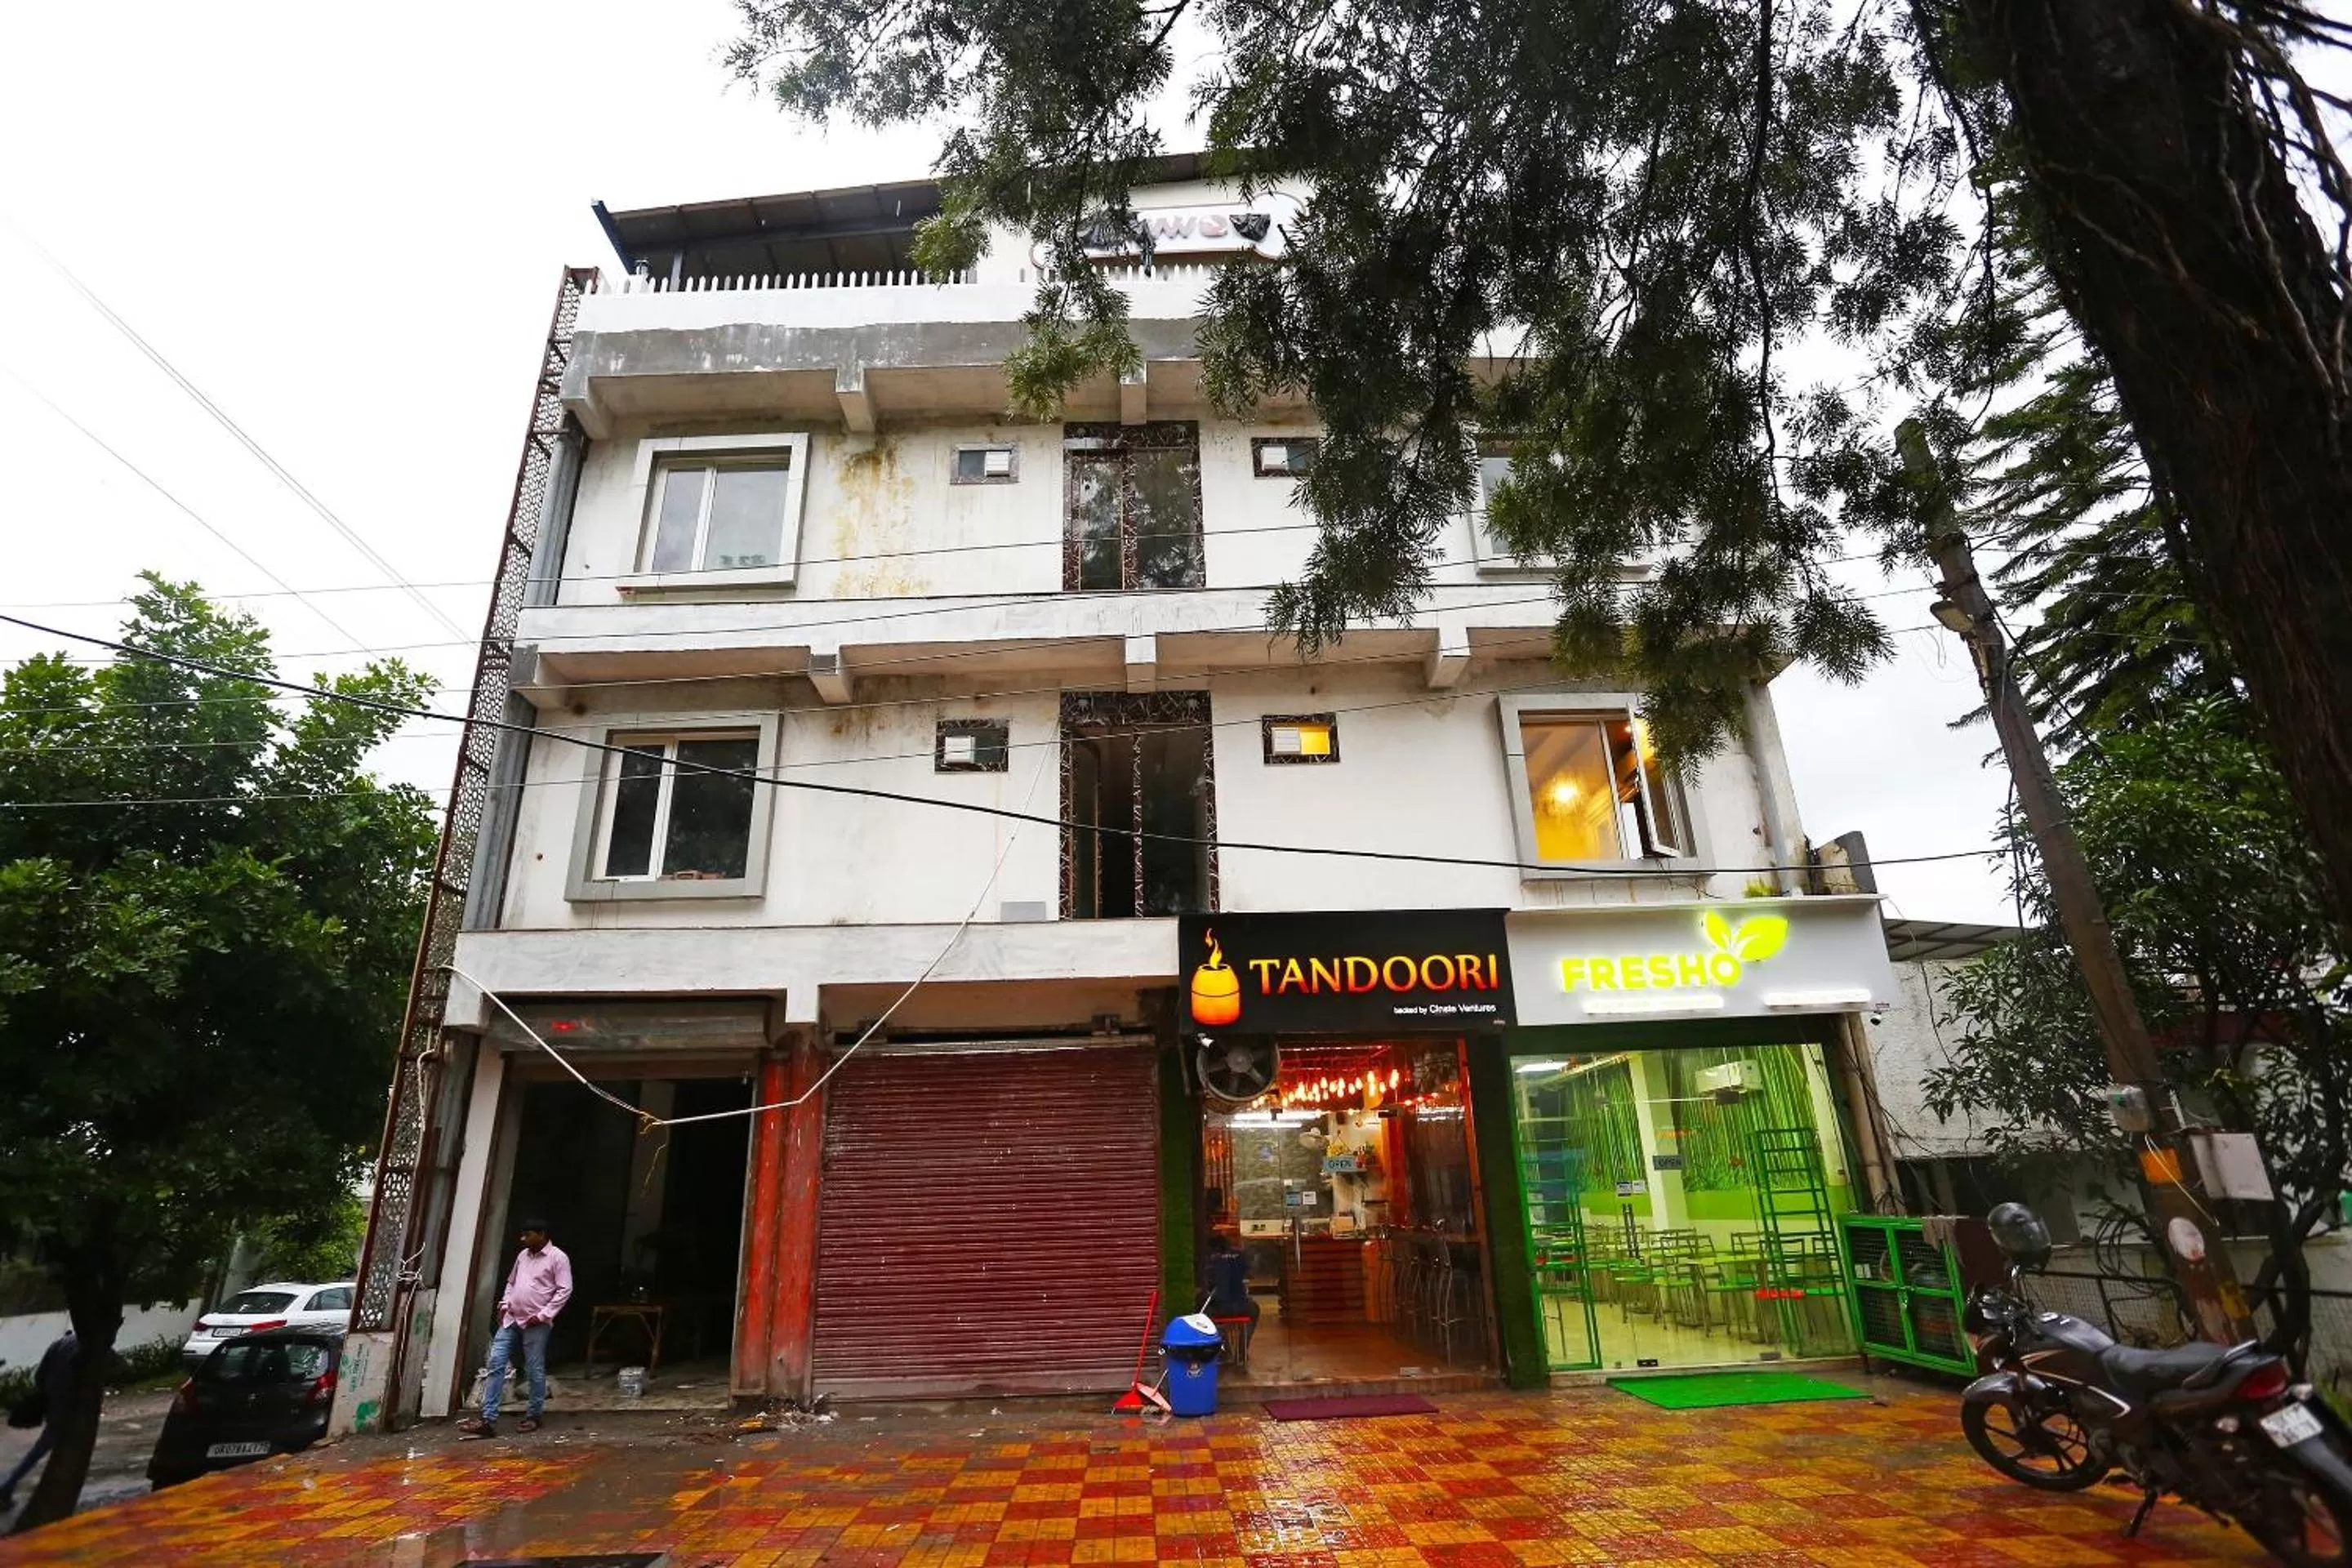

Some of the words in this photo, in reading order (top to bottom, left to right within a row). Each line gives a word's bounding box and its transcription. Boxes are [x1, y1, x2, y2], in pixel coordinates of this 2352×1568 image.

[1249, 954, 1499, 996] TANDOORI
[1561, 952, 1742, 991] FRESHO
[1419, 1006, 1428, 1015] by
[1458, 1004, 1497, 1013] Ventures
[1328, 1159, 1352, 1169] OPEN
[1657, 1158, 1682, 1168] OPEN
